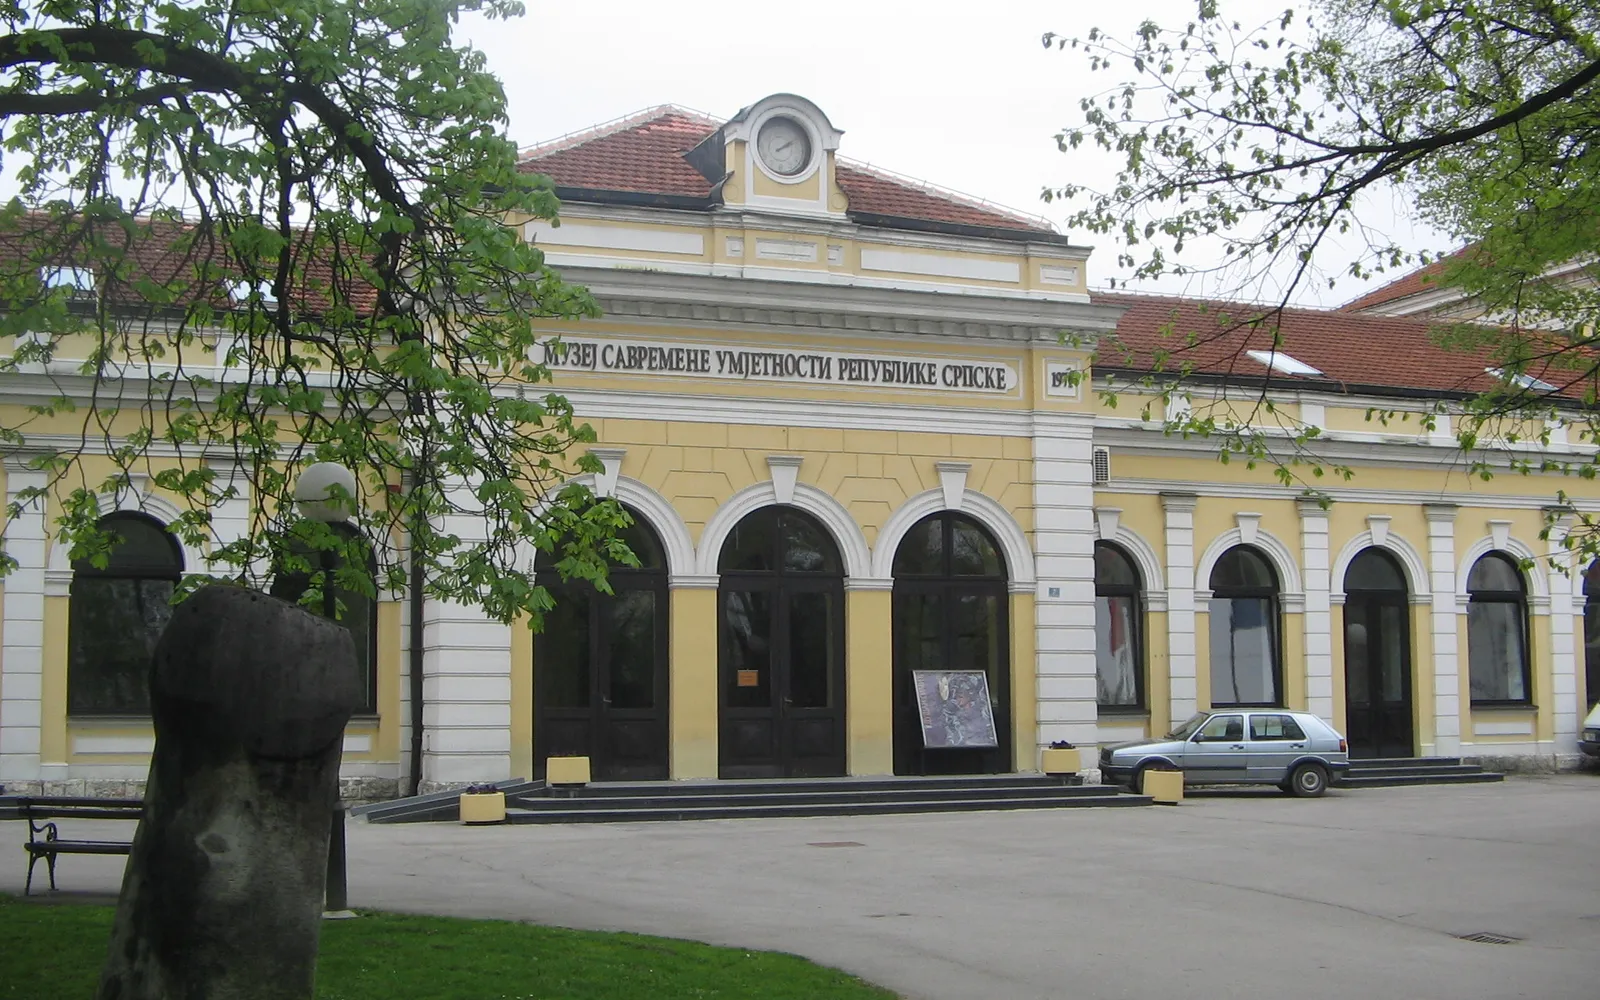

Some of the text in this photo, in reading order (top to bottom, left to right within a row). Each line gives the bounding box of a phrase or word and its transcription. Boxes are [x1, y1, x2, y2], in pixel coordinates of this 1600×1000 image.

[543, 341, 1007, 390] МУЗЕЈ САВРЕМЕНЕ УМЈЕТНОСТИ РЕПУБЛИКЕ СРПСКЕ
